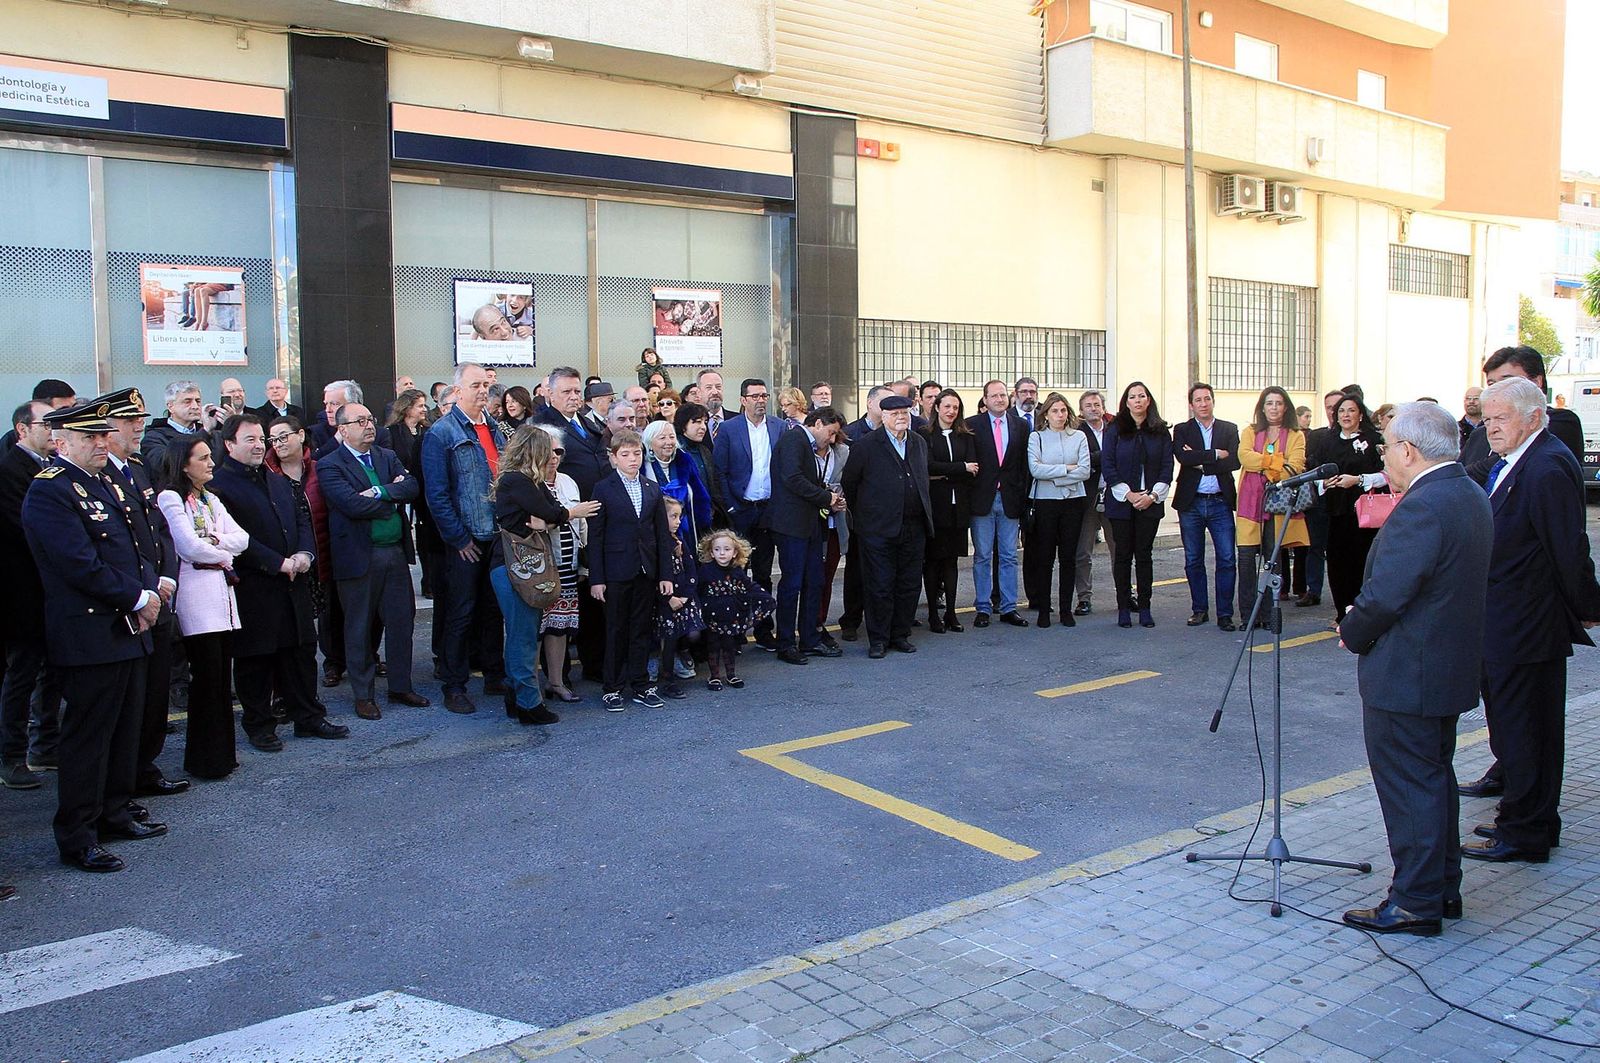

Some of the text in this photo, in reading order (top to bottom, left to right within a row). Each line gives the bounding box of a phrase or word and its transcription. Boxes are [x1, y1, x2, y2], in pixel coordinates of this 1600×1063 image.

[60, 85, 67, 94] y
[0, 90, 90, 108] edicina Estética
[152, 335, 178, 343] Libera
[219, 336, 225, 344] 3
[1584, 455, 1598, 463] 091
